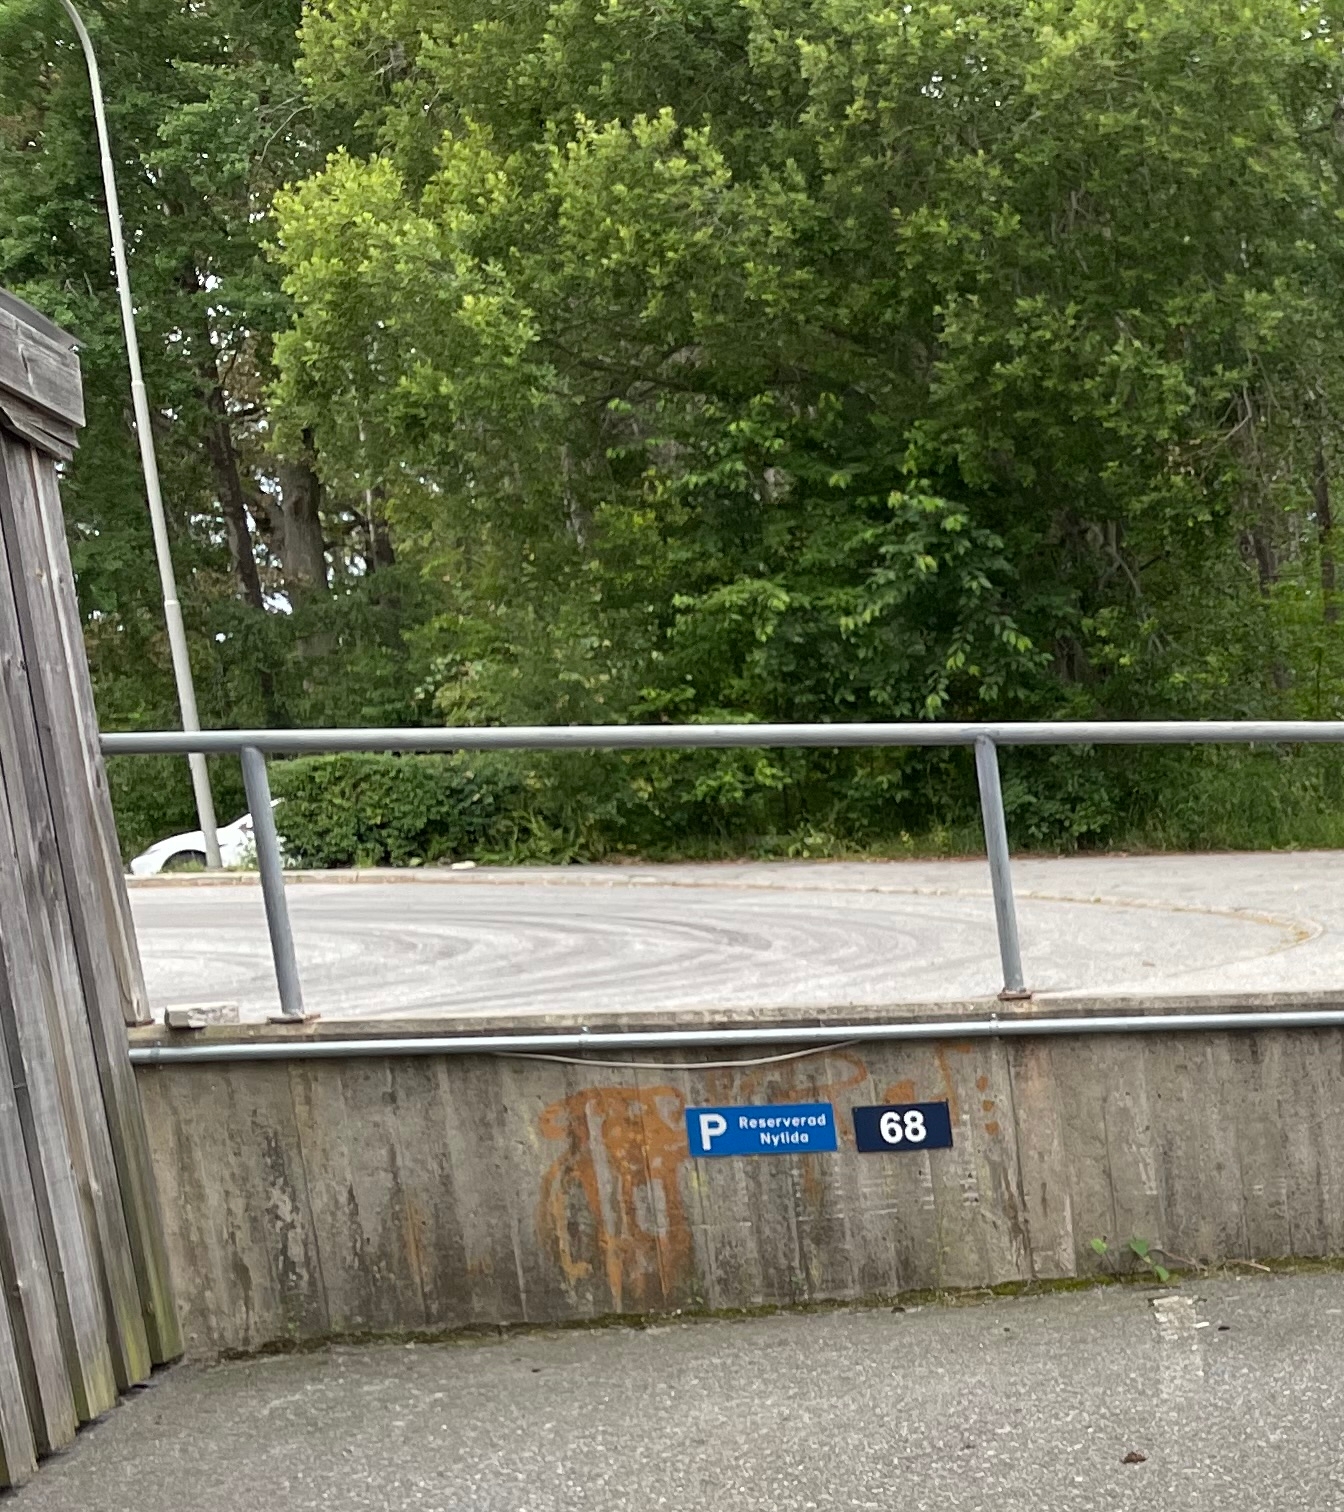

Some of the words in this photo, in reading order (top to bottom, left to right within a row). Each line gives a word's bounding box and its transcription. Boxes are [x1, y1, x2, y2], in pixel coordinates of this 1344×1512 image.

[699, 1113, 727, 1151] P
[739, 1113, 827, 1130] Reserverad
[879, 1110, 927, 1144] 68
